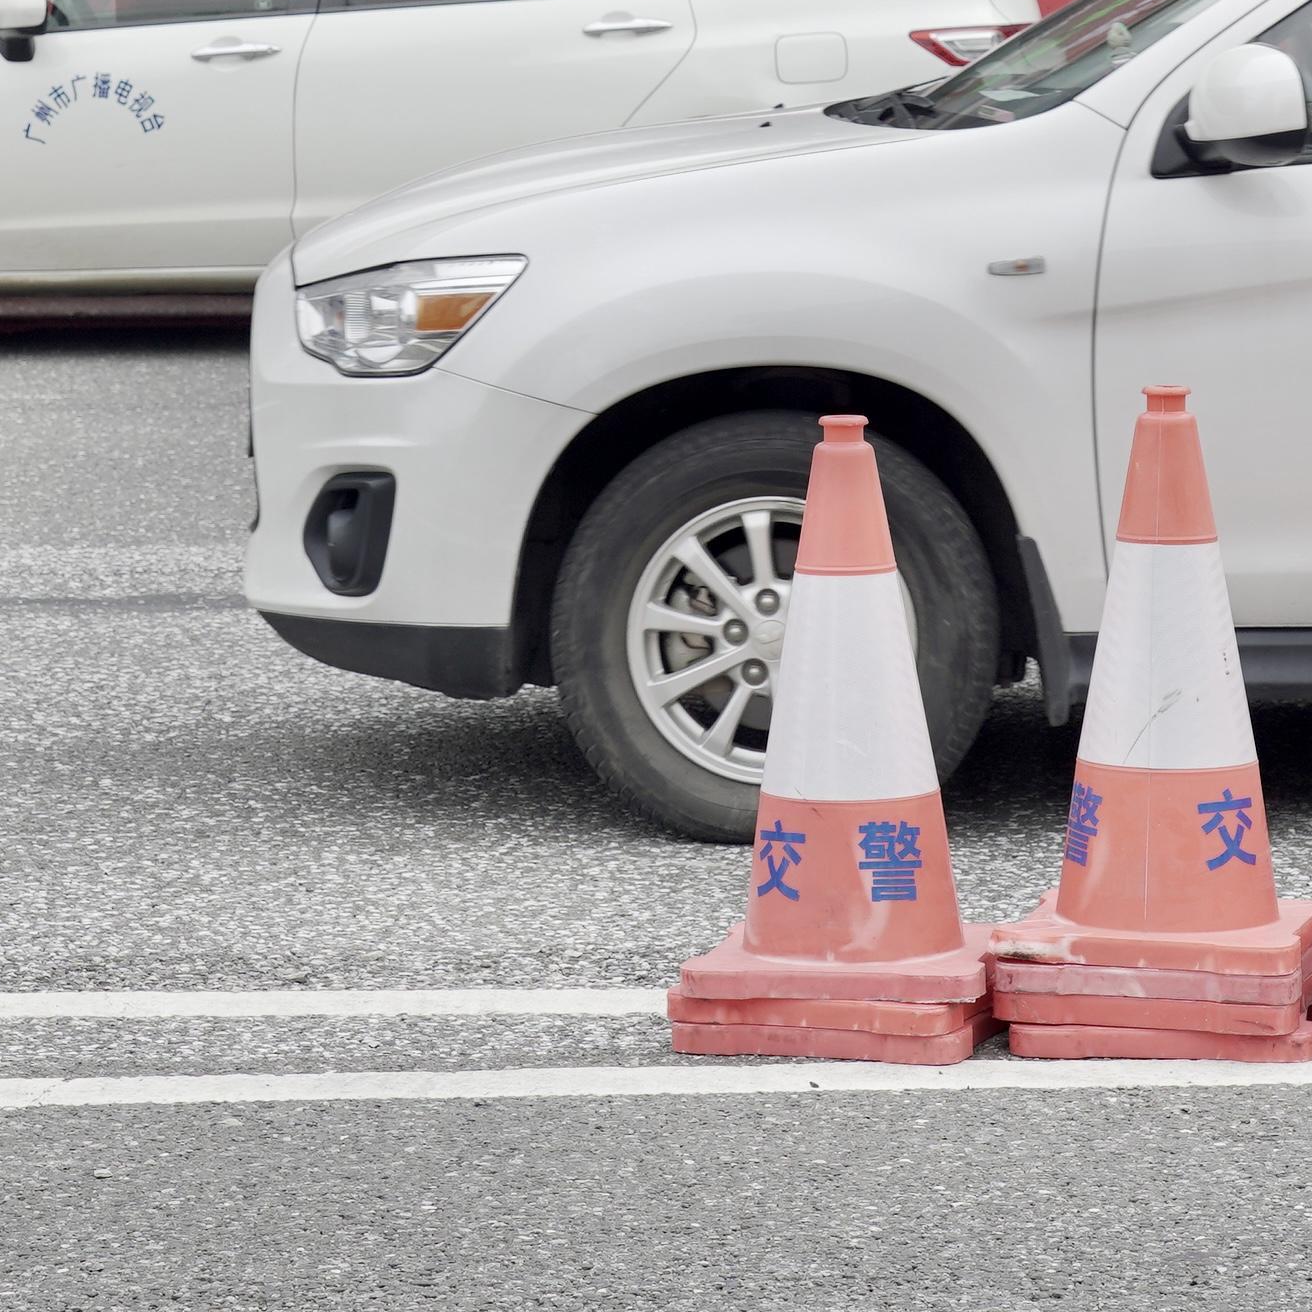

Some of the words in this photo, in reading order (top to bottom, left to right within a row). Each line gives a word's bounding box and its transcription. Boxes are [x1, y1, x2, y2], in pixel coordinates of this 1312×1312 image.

[23, 72, 165, 144] 广州市广播电视台
[756, 818, 924, 904] 交警
